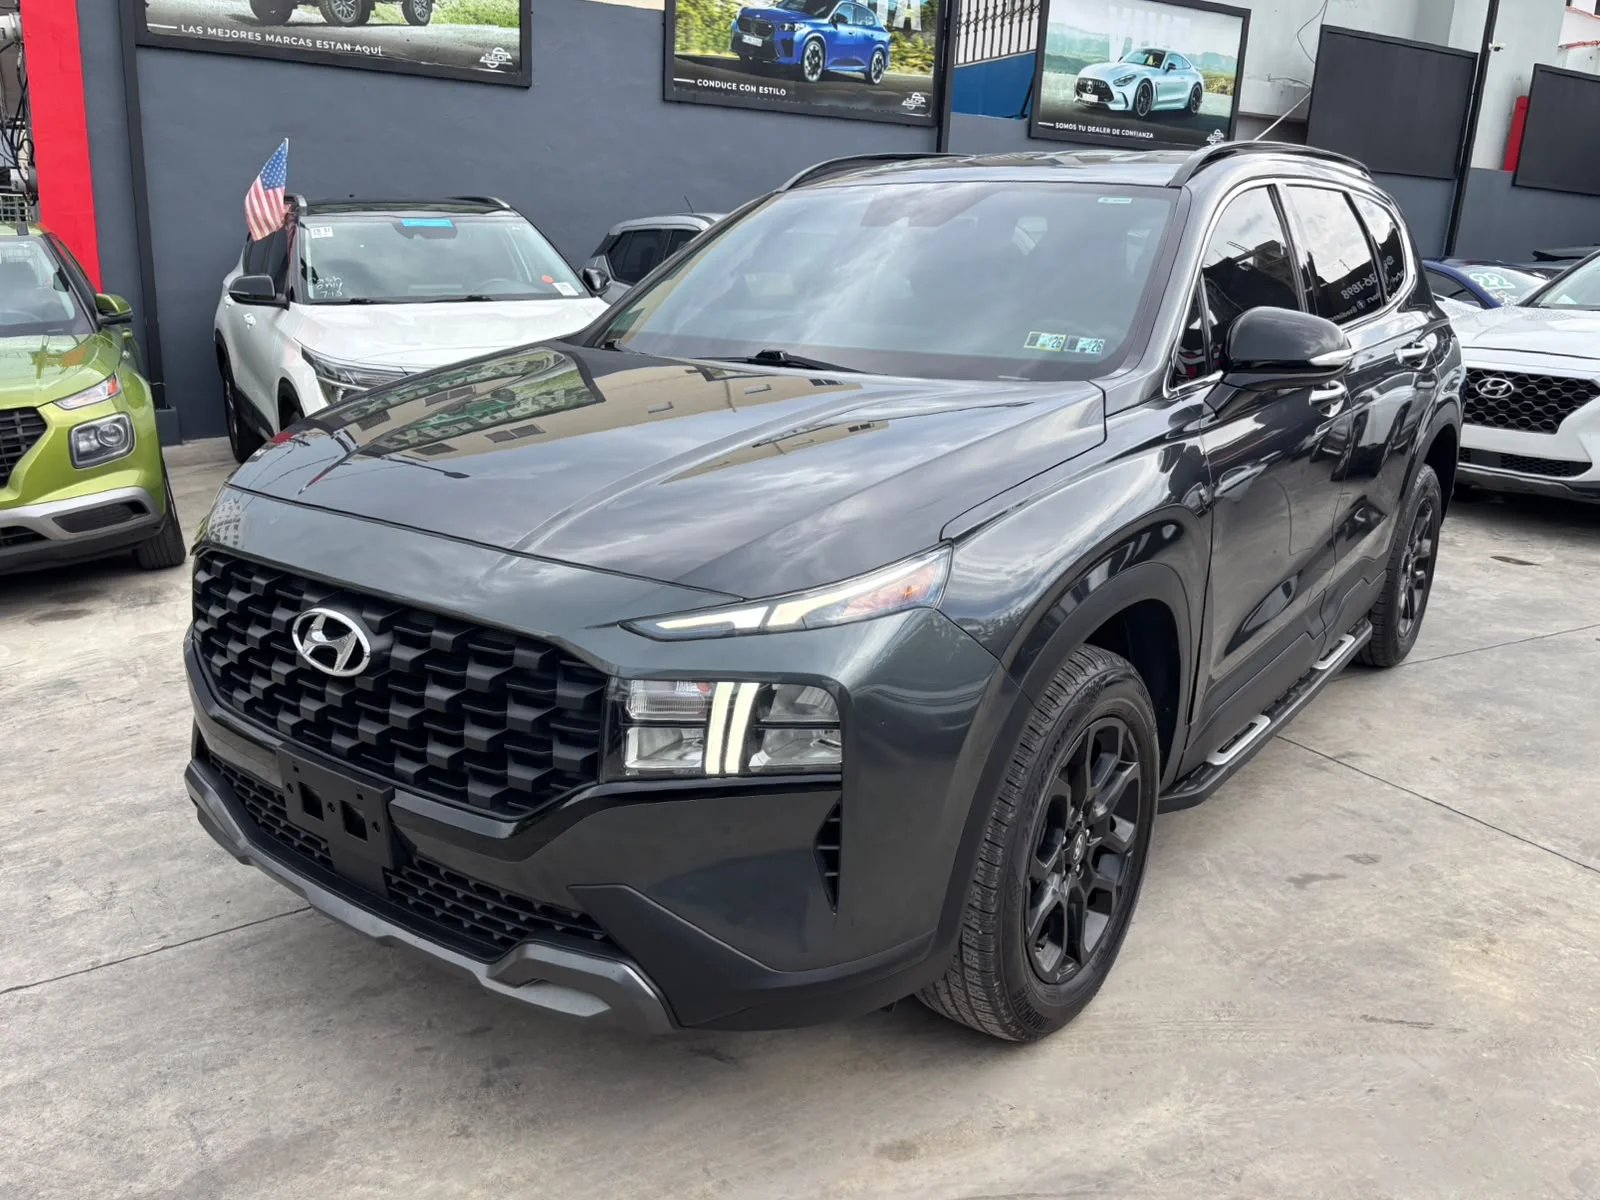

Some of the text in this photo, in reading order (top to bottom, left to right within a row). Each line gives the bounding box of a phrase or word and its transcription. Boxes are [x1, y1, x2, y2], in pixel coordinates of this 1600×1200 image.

[181, 24, 204, 34] LAS
[207, 27, 262, 41] MEJORES
[265, 33, 313, 47] MARCAS
[316, 40, 351, 51] ESTAN
[696, 78, 787, 96] CONDUCE CON ESTILO
[1055, 122, 1077, 131] SOMOS
[1078, 124, 1087, 132] TU
[1087, 125, 1111, 134] DEALER
[1120, 129, 1154, 139] CONFIANZA
